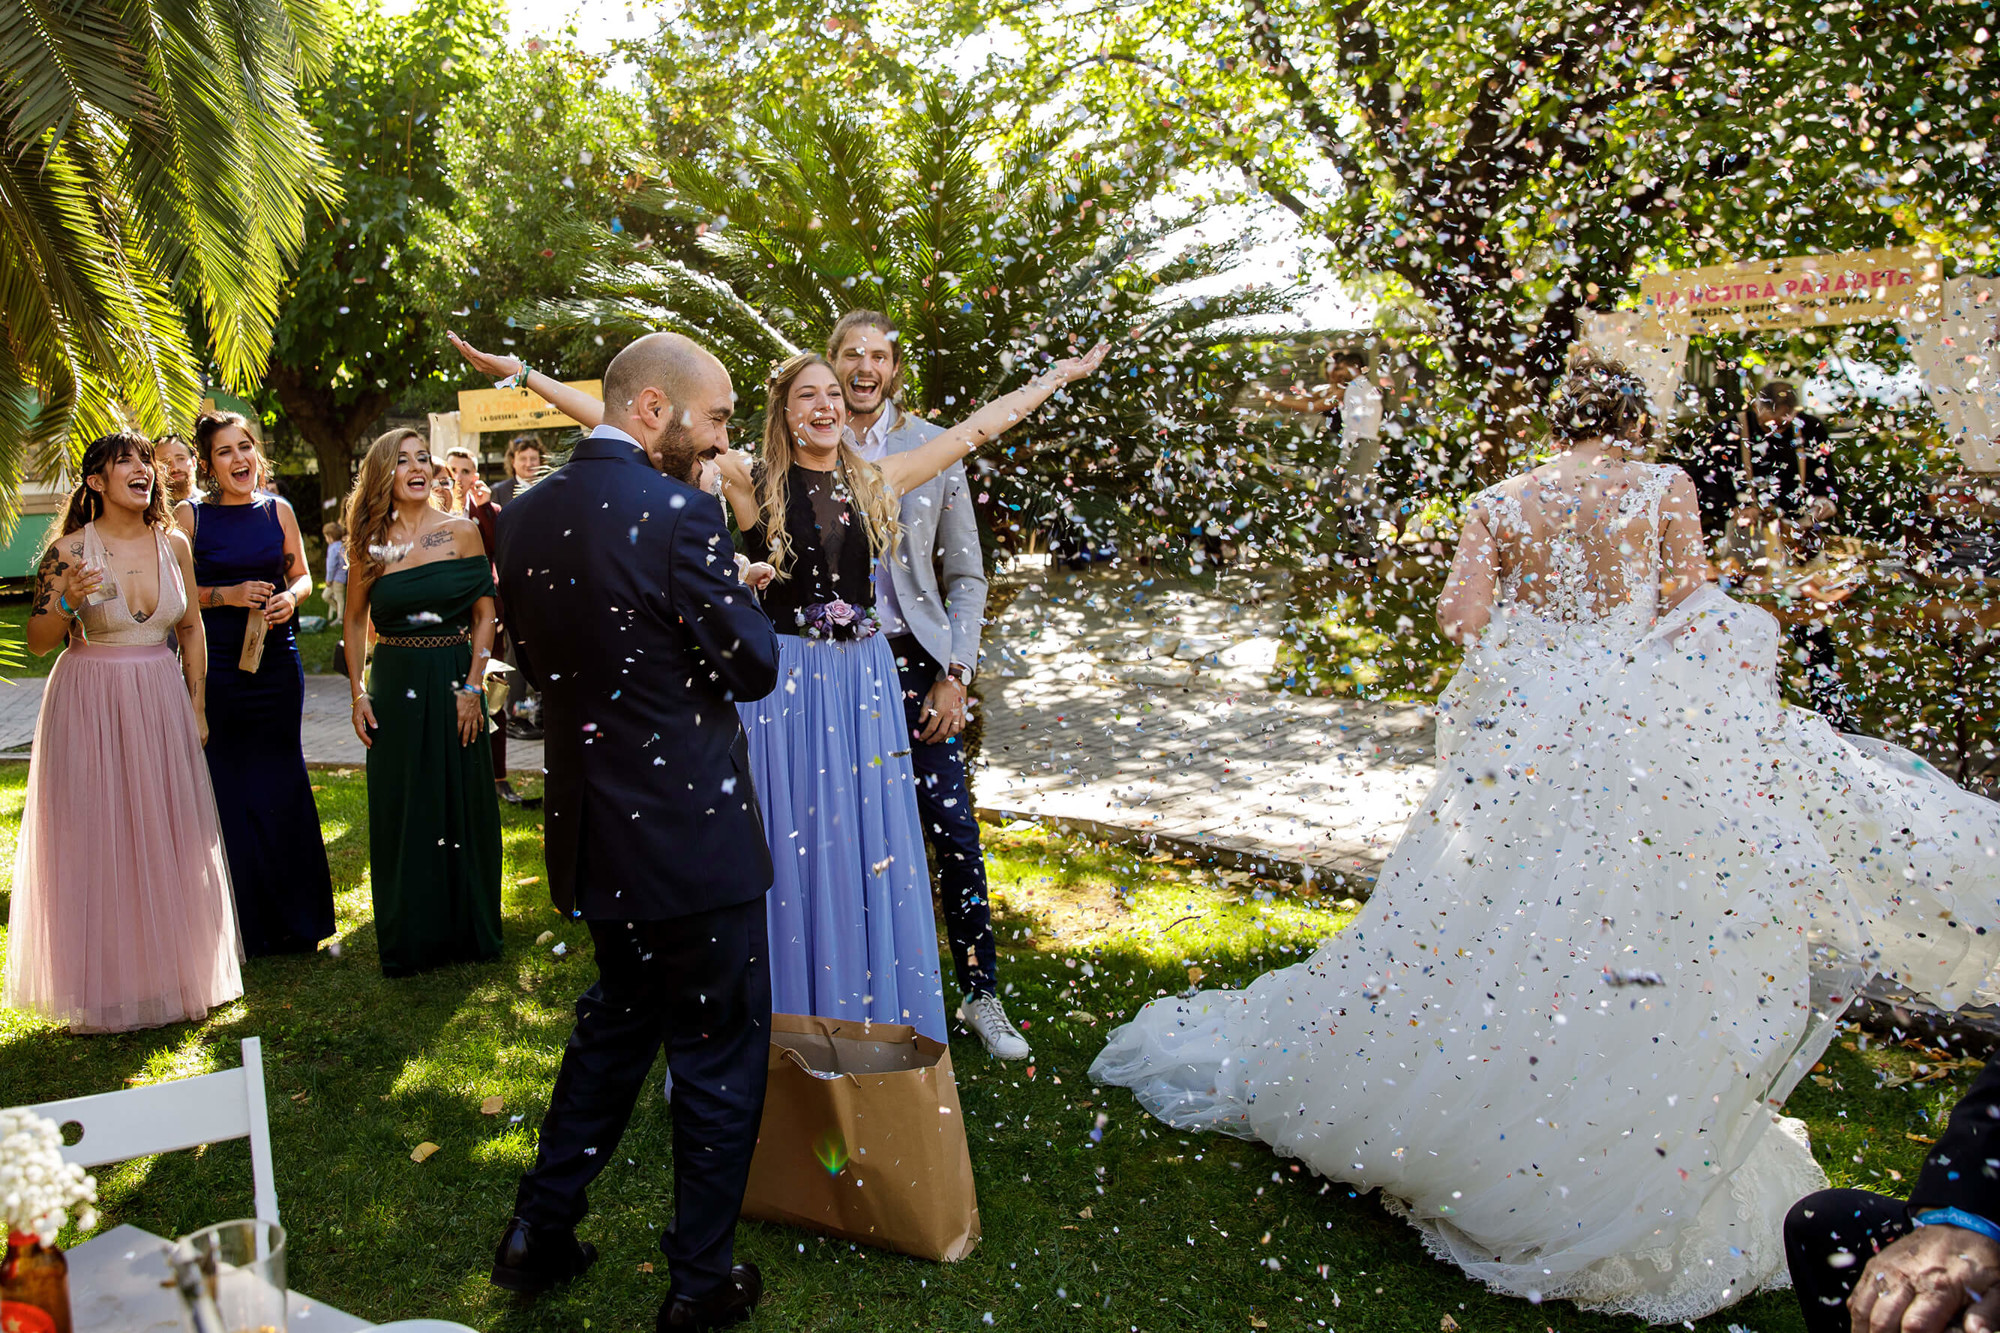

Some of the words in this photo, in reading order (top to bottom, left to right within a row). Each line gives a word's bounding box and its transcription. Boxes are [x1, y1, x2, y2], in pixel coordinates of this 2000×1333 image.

[1656, 290, 1681, 306] LA
[1689, 281, 1777, 304] NOSTRA
[1784, 269, 1914, 297] PARADETA
[1745, 303, 1782, 313] BUFFE
